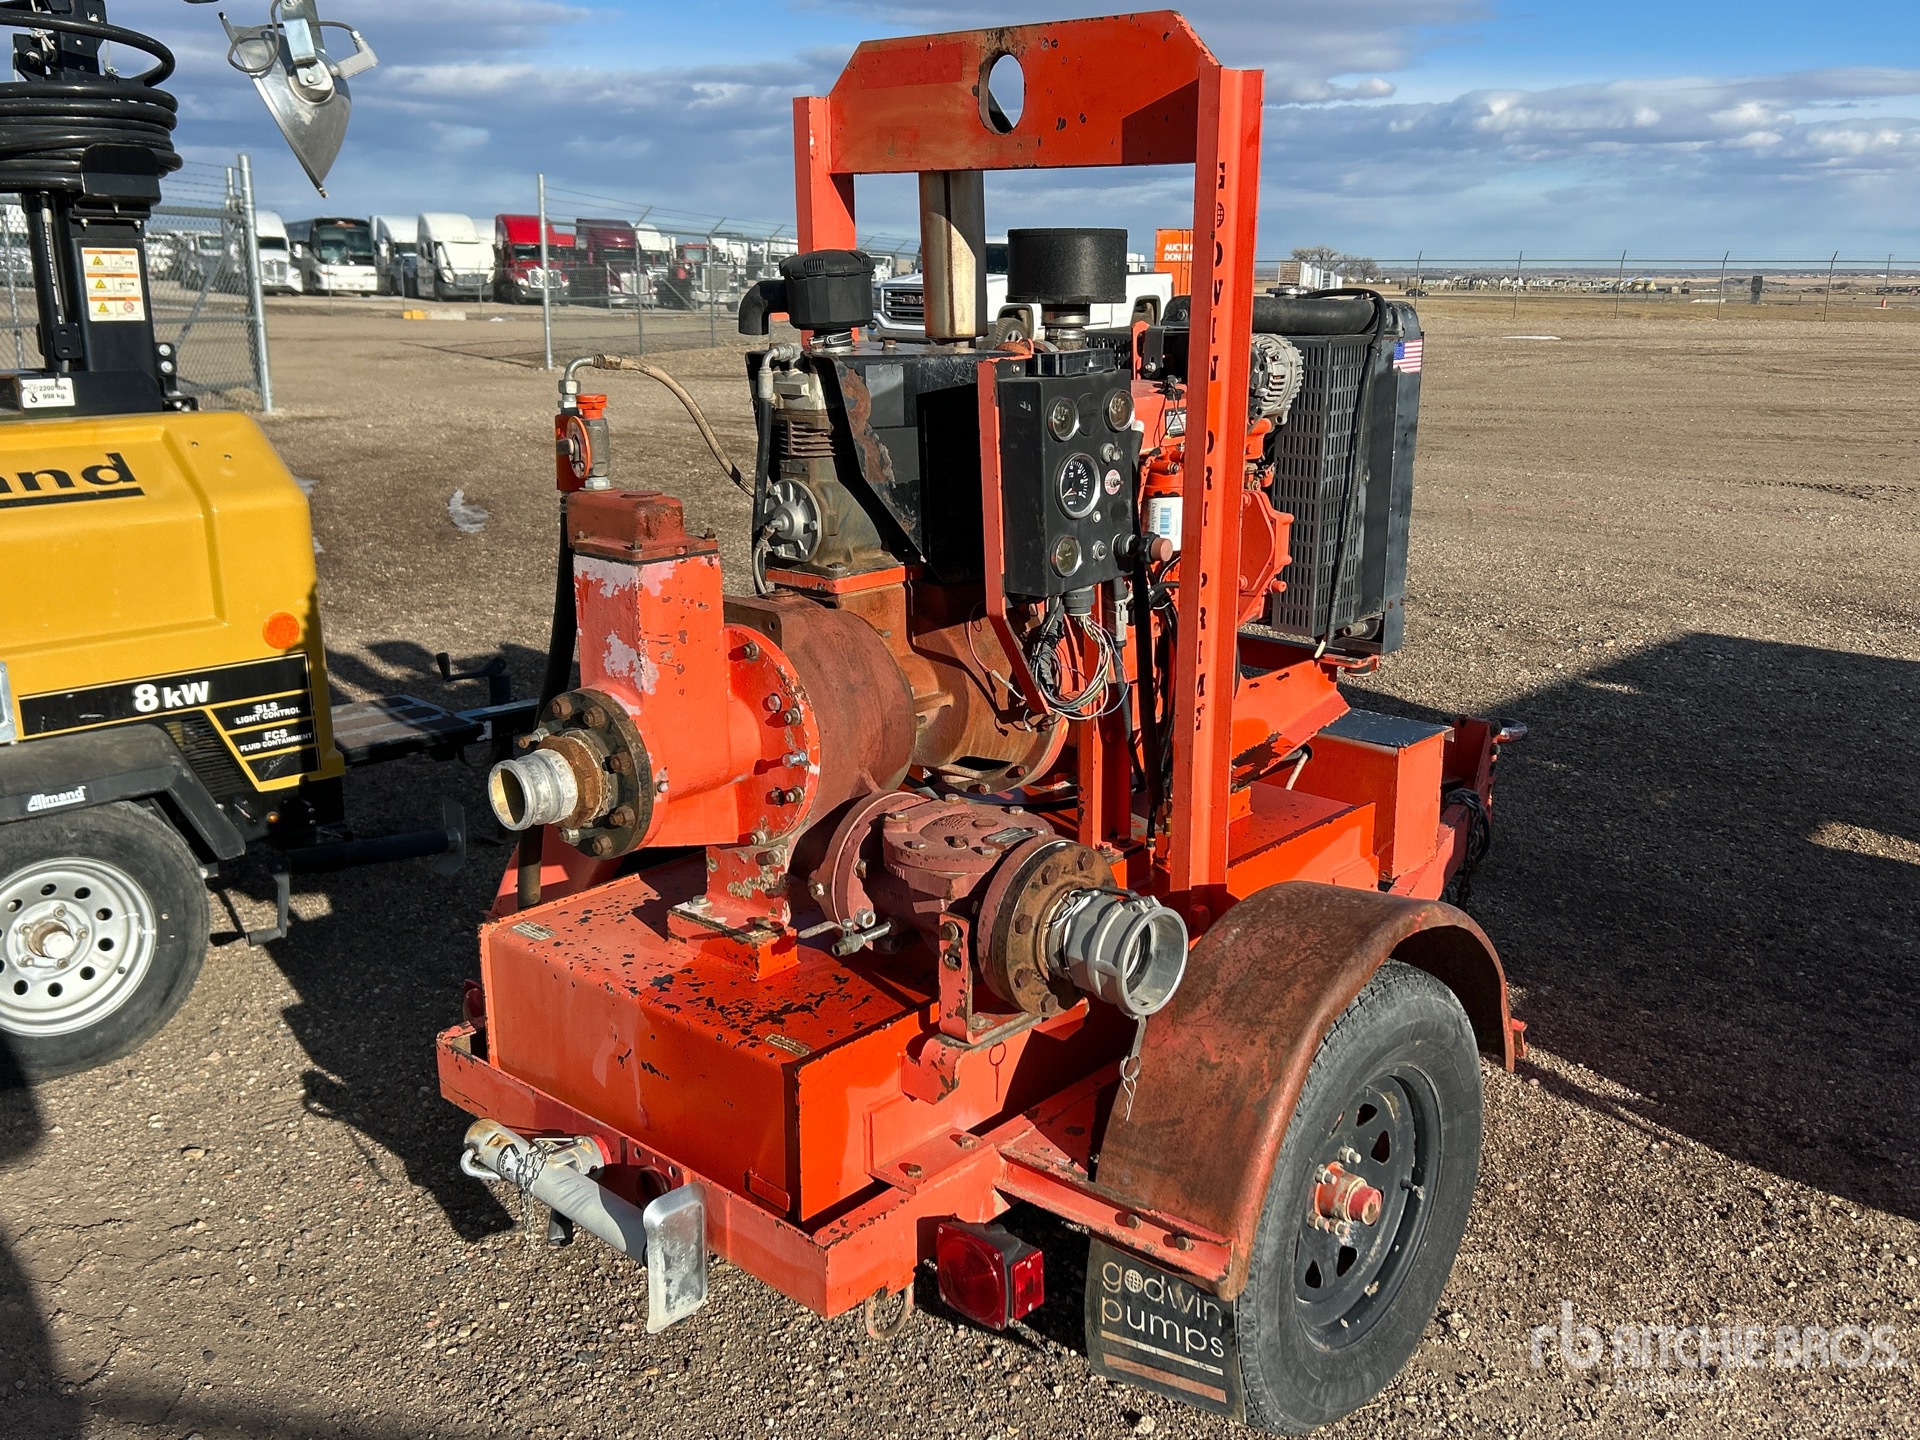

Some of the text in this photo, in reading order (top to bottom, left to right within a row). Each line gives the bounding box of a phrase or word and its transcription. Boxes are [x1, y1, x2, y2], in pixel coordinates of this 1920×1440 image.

[133, 680, 210, 713] 8 kW
[235, 706, 301, 725] LIGHT CONTROL
[254, 701, 278, 714] SLS
[239, 732, 313, 753] FLUID CONTAINMENT
[263, 728, 288, 741] FCS
[28, 785, 87, 812] Allmand
[1101, 1296, 1225, 1358] pumps
